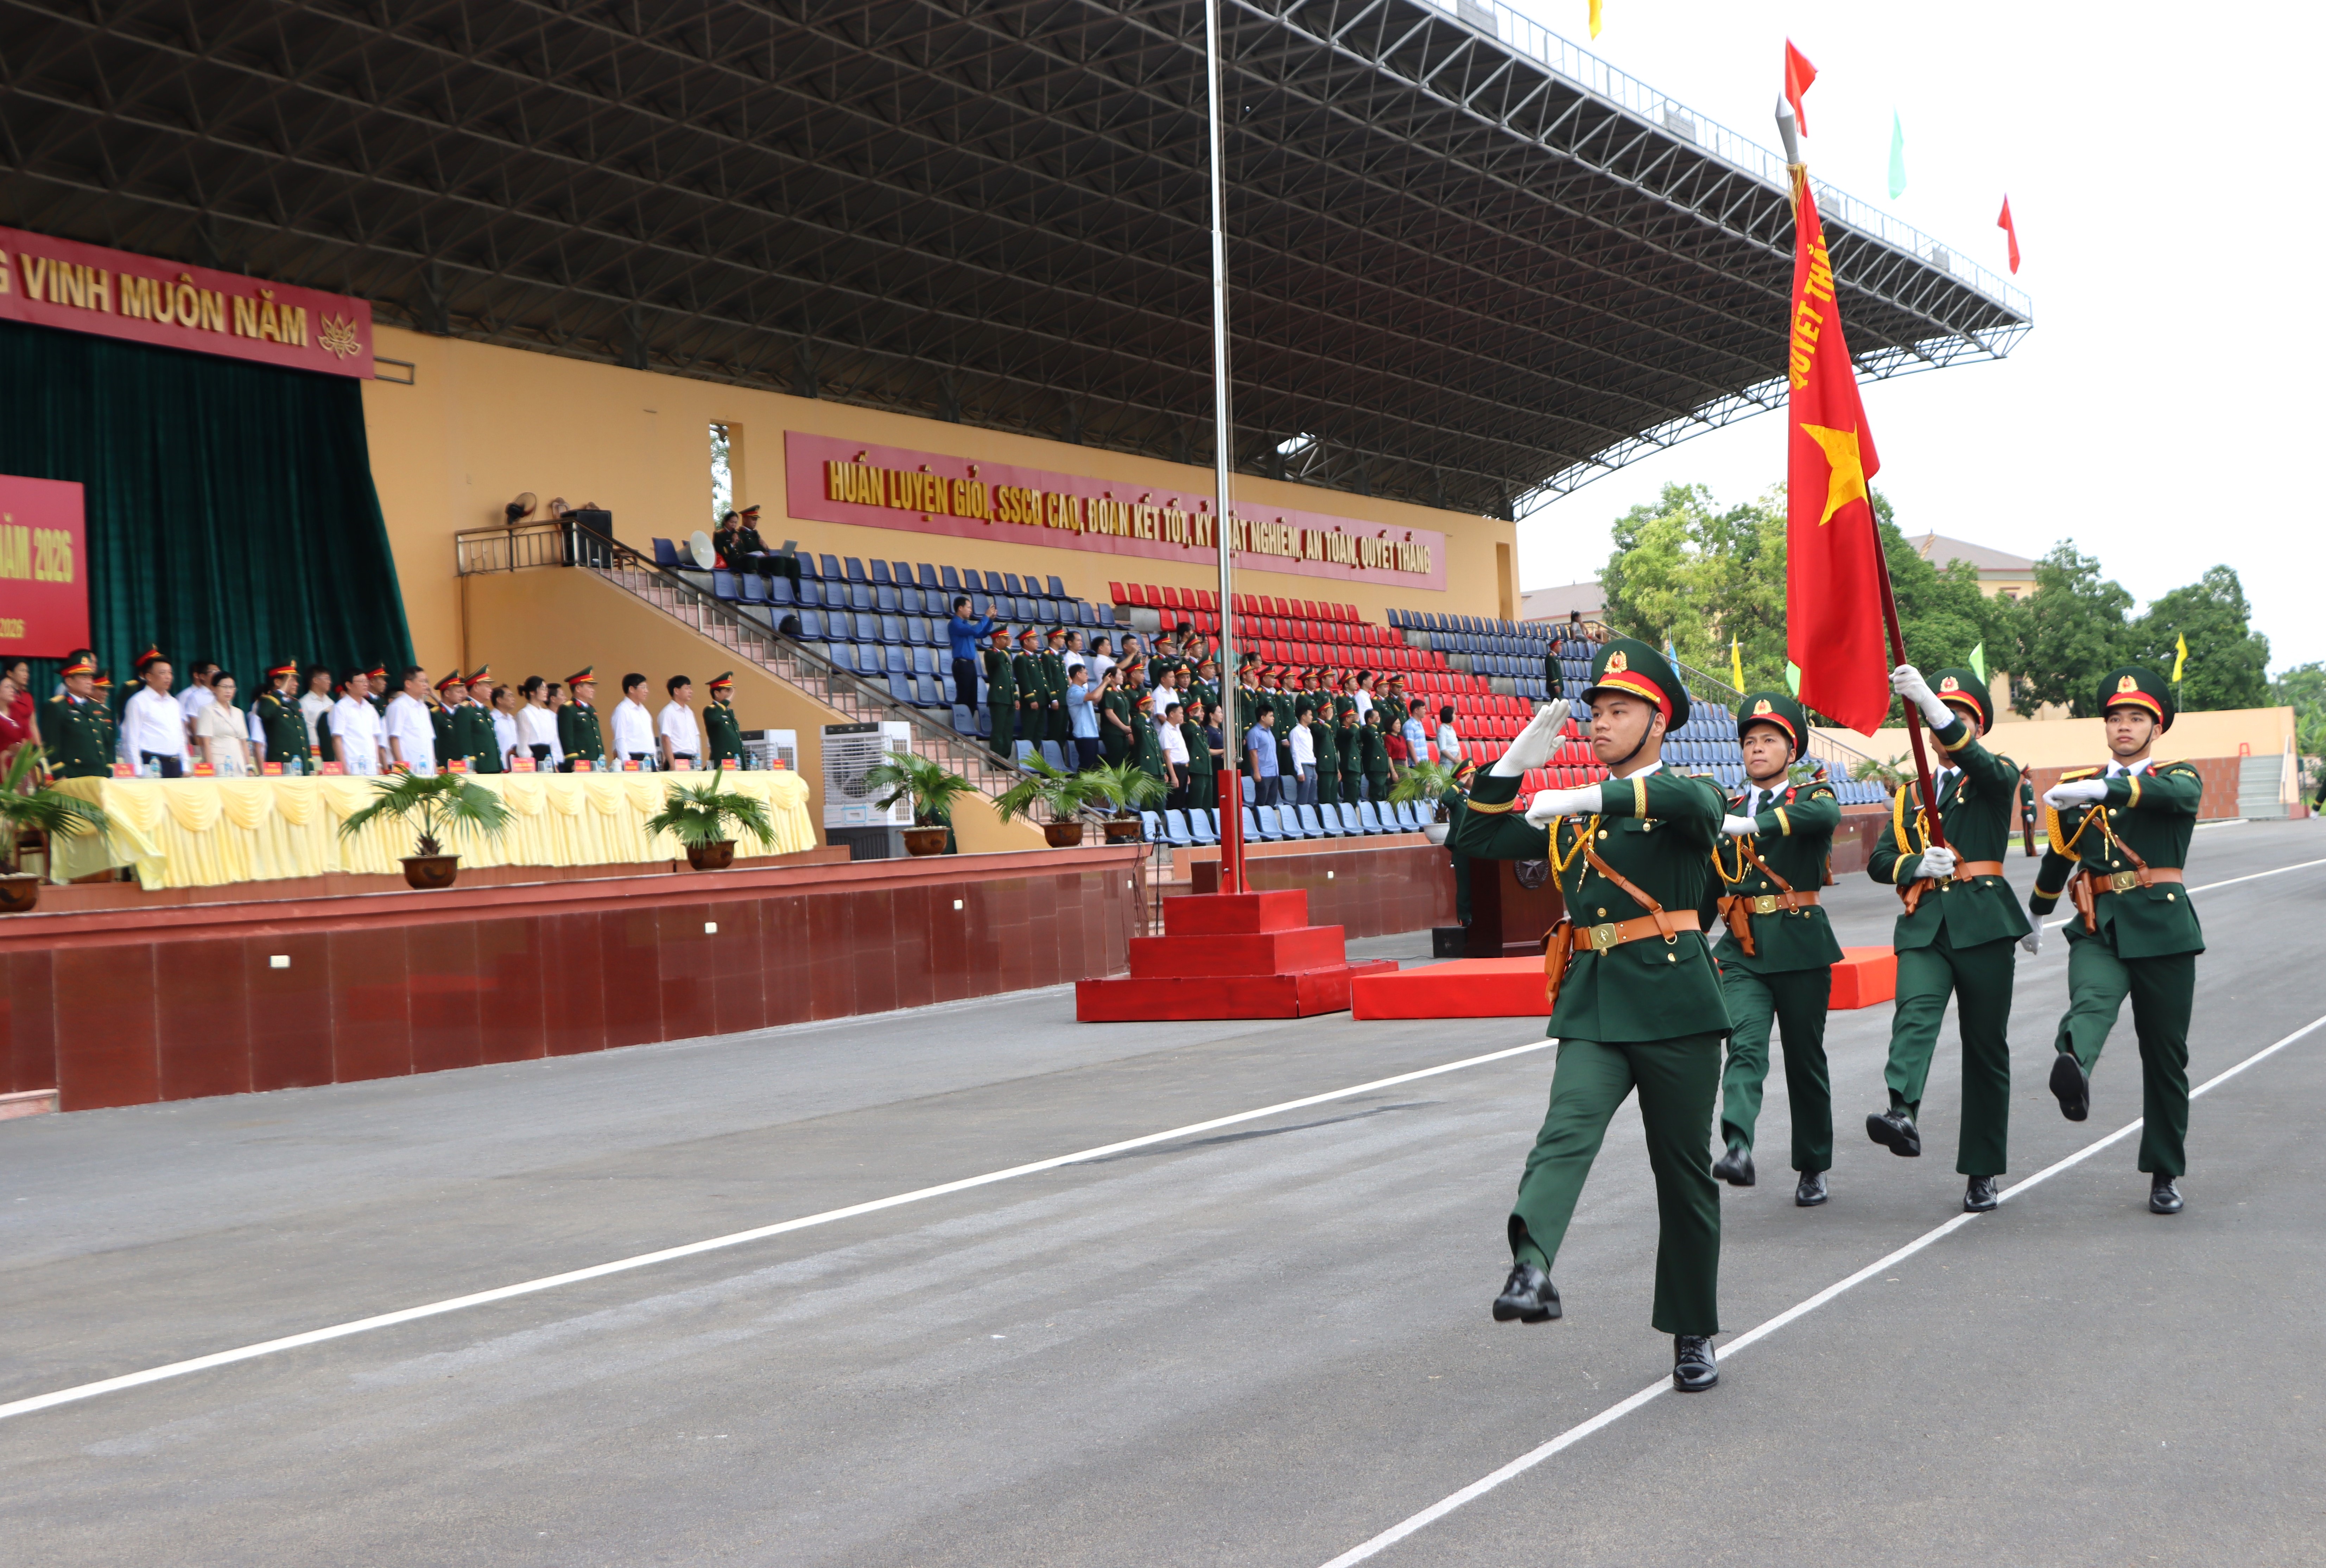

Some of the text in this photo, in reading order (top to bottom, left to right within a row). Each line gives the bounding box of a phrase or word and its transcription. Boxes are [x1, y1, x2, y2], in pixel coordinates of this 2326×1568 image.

[20, 253, 110, 312] VINH
[120, 272, 224, 332] MUÔN
[233, 288, 308, 346] NĂM
[1789, 224, 1834, 390] QUYẾT THẮ
[0, 512, 73, 583] ĂM 2026
[830, 450, 1431, 573] HUẤN LUYỆN GIỎI, SSCĐ CAO, ĐOÀN KẾT TỐT, KỶ ẬT NGHIÊM, AN TOÀN, QUYẾT THẮNG
